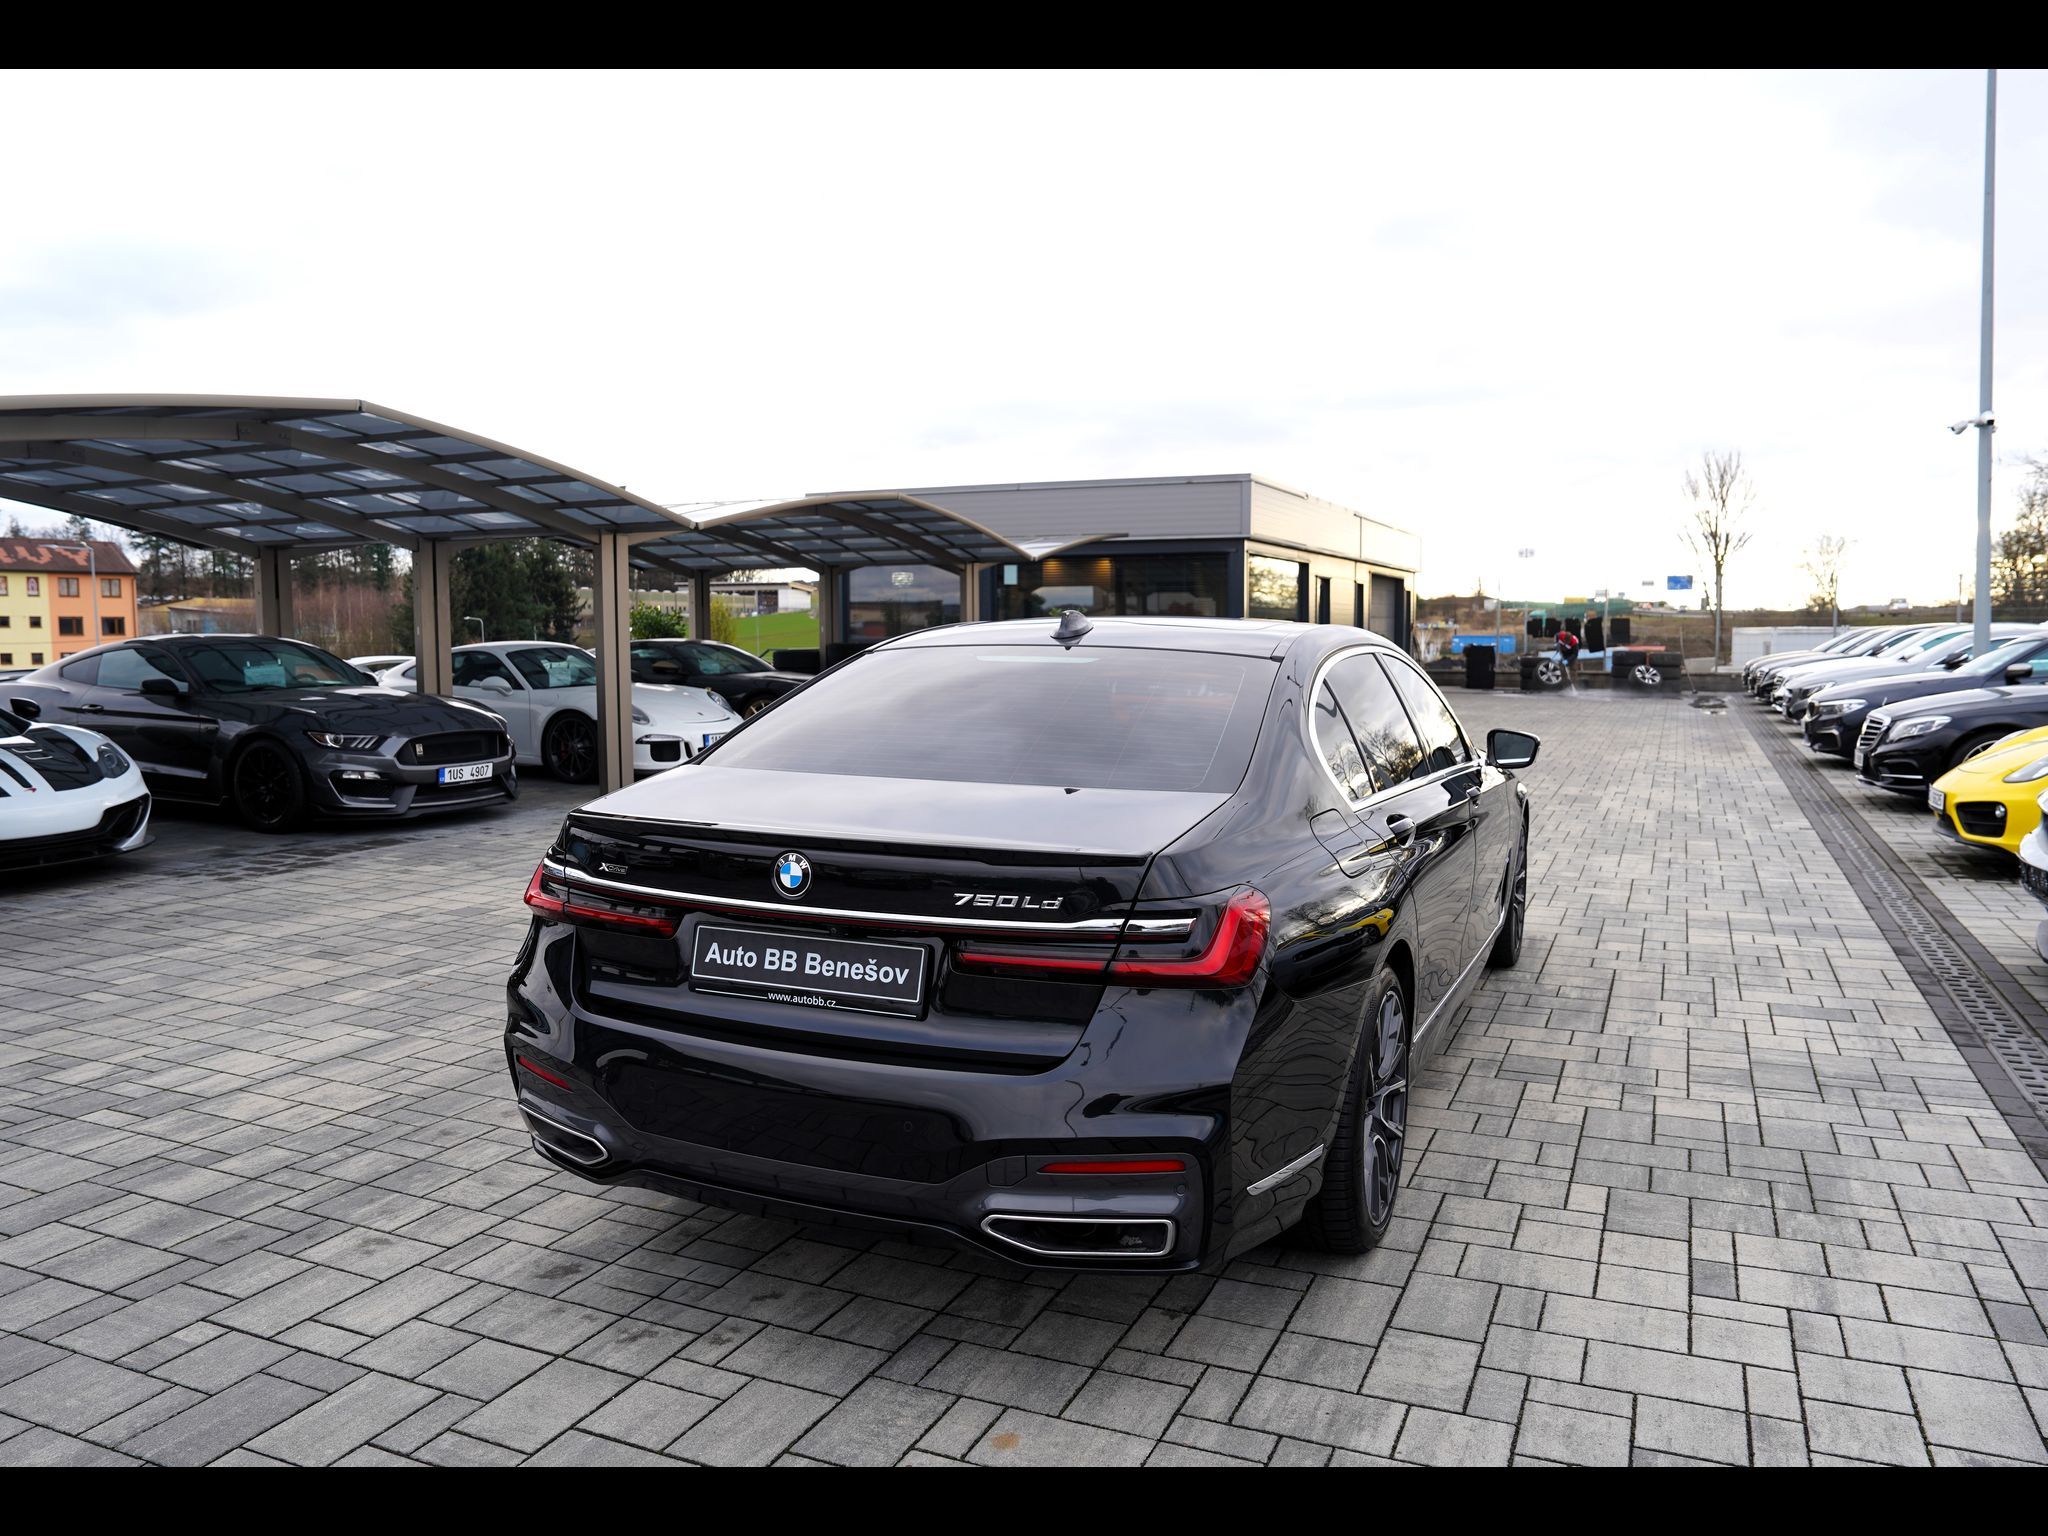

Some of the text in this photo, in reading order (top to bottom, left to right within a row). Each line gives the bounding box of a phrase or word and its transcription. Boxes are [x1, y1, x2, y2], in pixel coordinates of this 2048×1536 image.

[447, 765, 490, 780] 1US 4907
[776, 854, 809, 870] BMW
[704, 942, 910, 985] Auto BB Benešov
[767, 992, 837, 1007] www.autobb.cz
